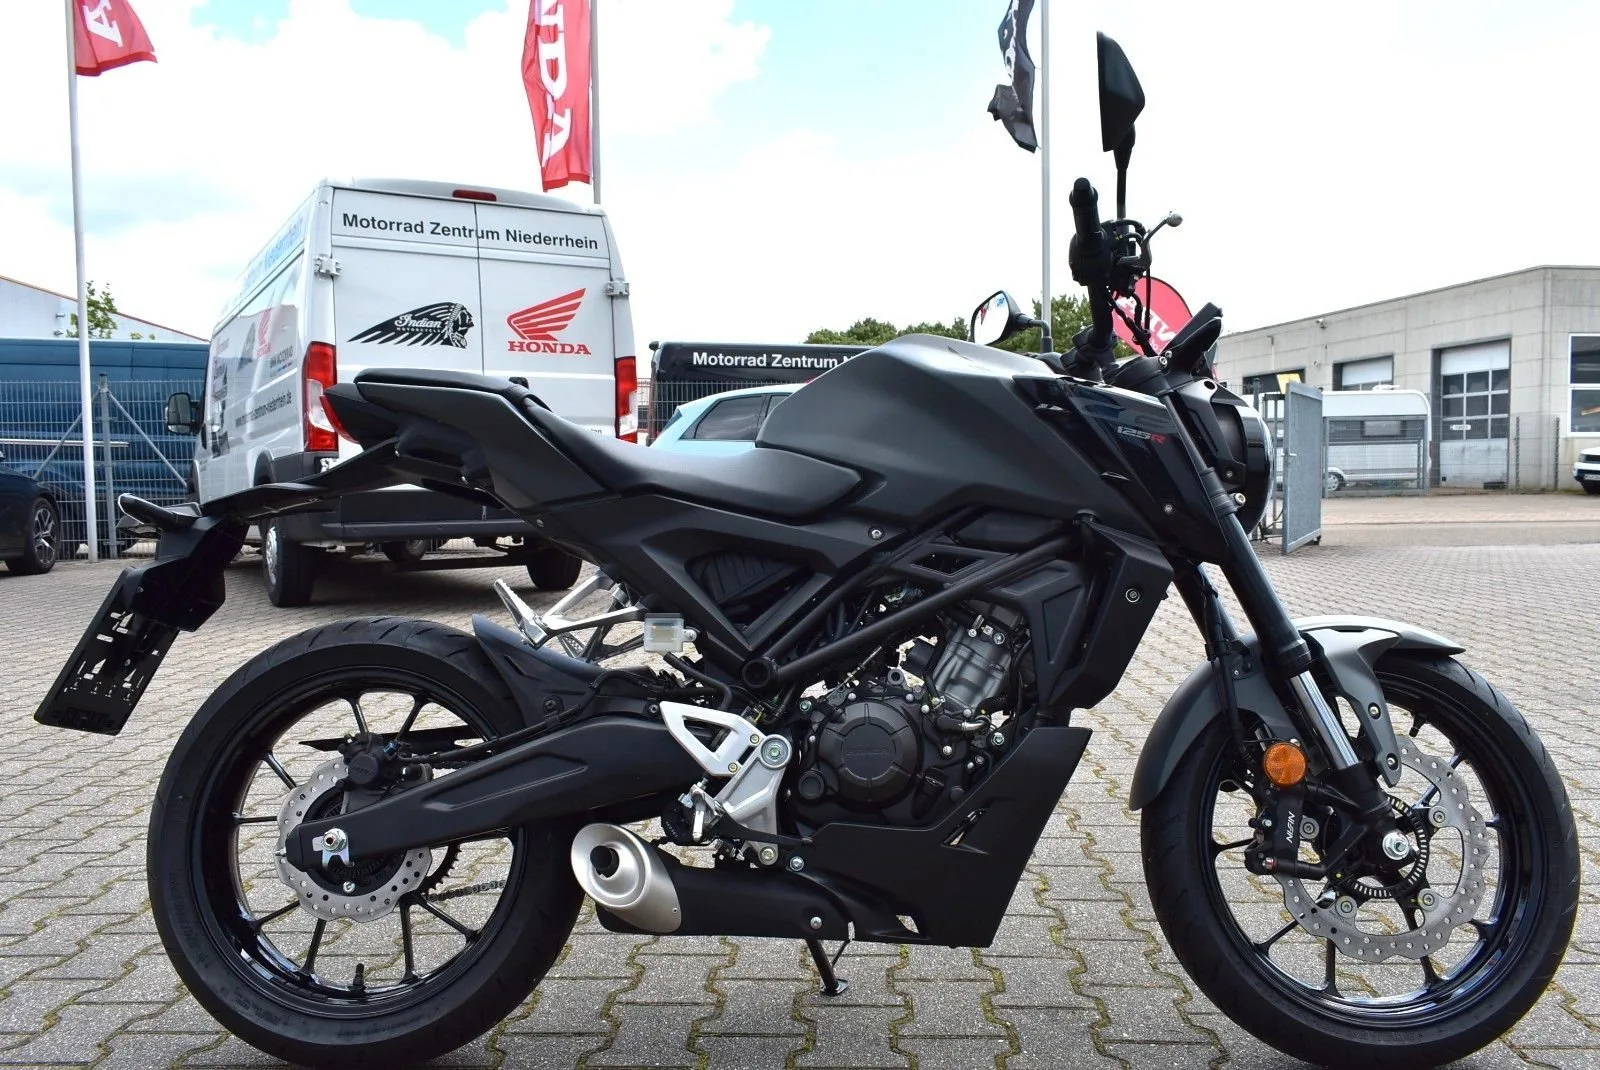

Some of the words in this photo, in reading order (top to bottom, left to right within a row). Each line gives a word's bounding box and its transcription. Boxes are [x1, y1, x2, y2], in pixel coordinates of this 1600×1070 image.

[343, 213, 424, 234] Motorrad
[429, 221, 500, 241] Zentrum
[505, 229, 598, 250] Niederrhein
[394, 314, 442, 328] Indian
[508, 340, 591, 355] HONDA
[693, 352, 767, 367] Motorrad
[771, 354, 838, 368] Zentrum
